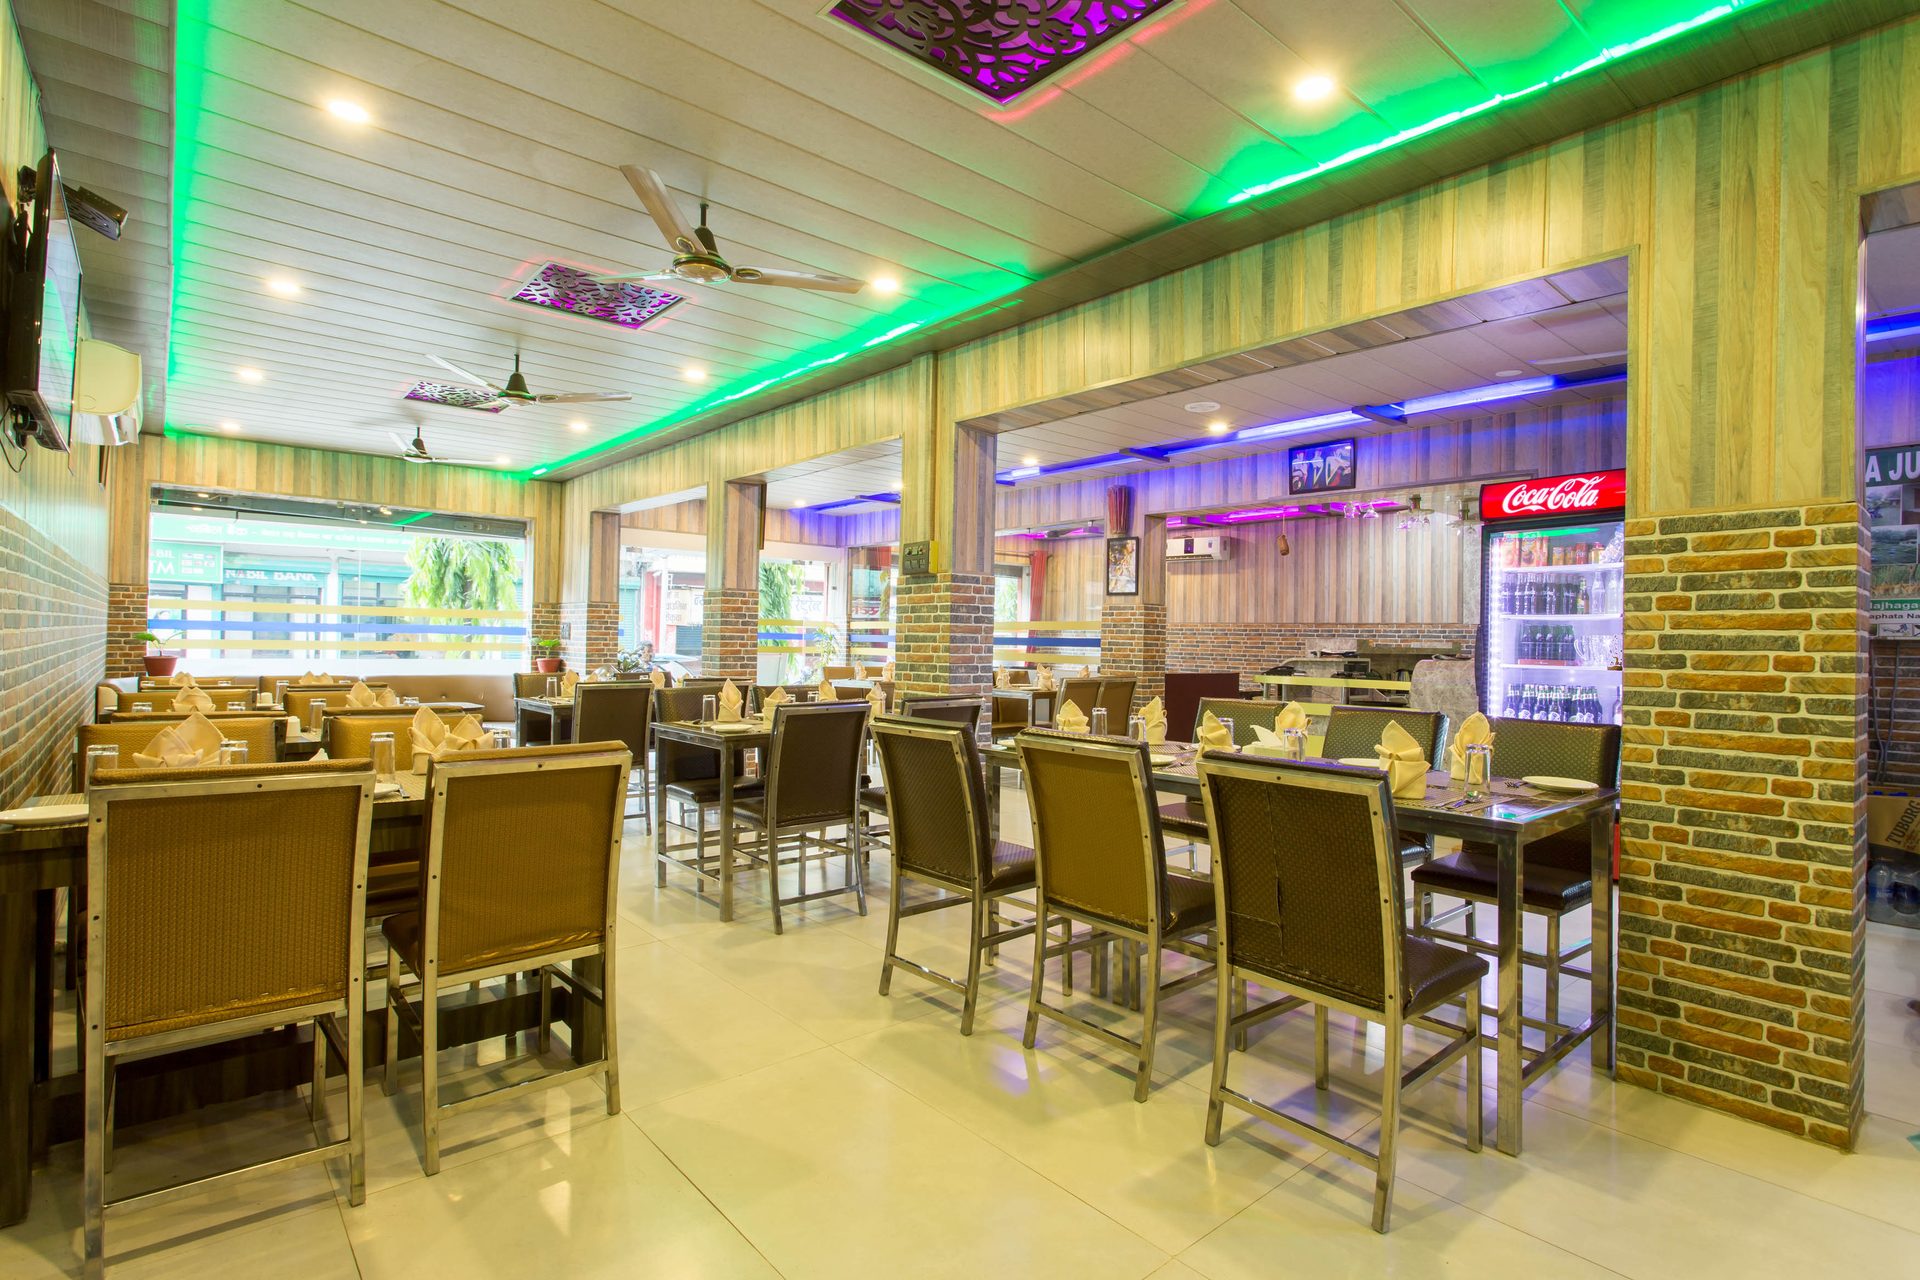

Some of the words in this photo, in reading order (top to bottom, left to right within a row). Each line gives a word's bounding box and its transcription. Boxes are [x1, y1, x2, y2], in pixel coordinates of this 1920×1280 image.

[1865, 455, 1882, 482] A
[1502, 476, 1607, 514] Coca-Cola
[149, 560, 175, 575] TM
